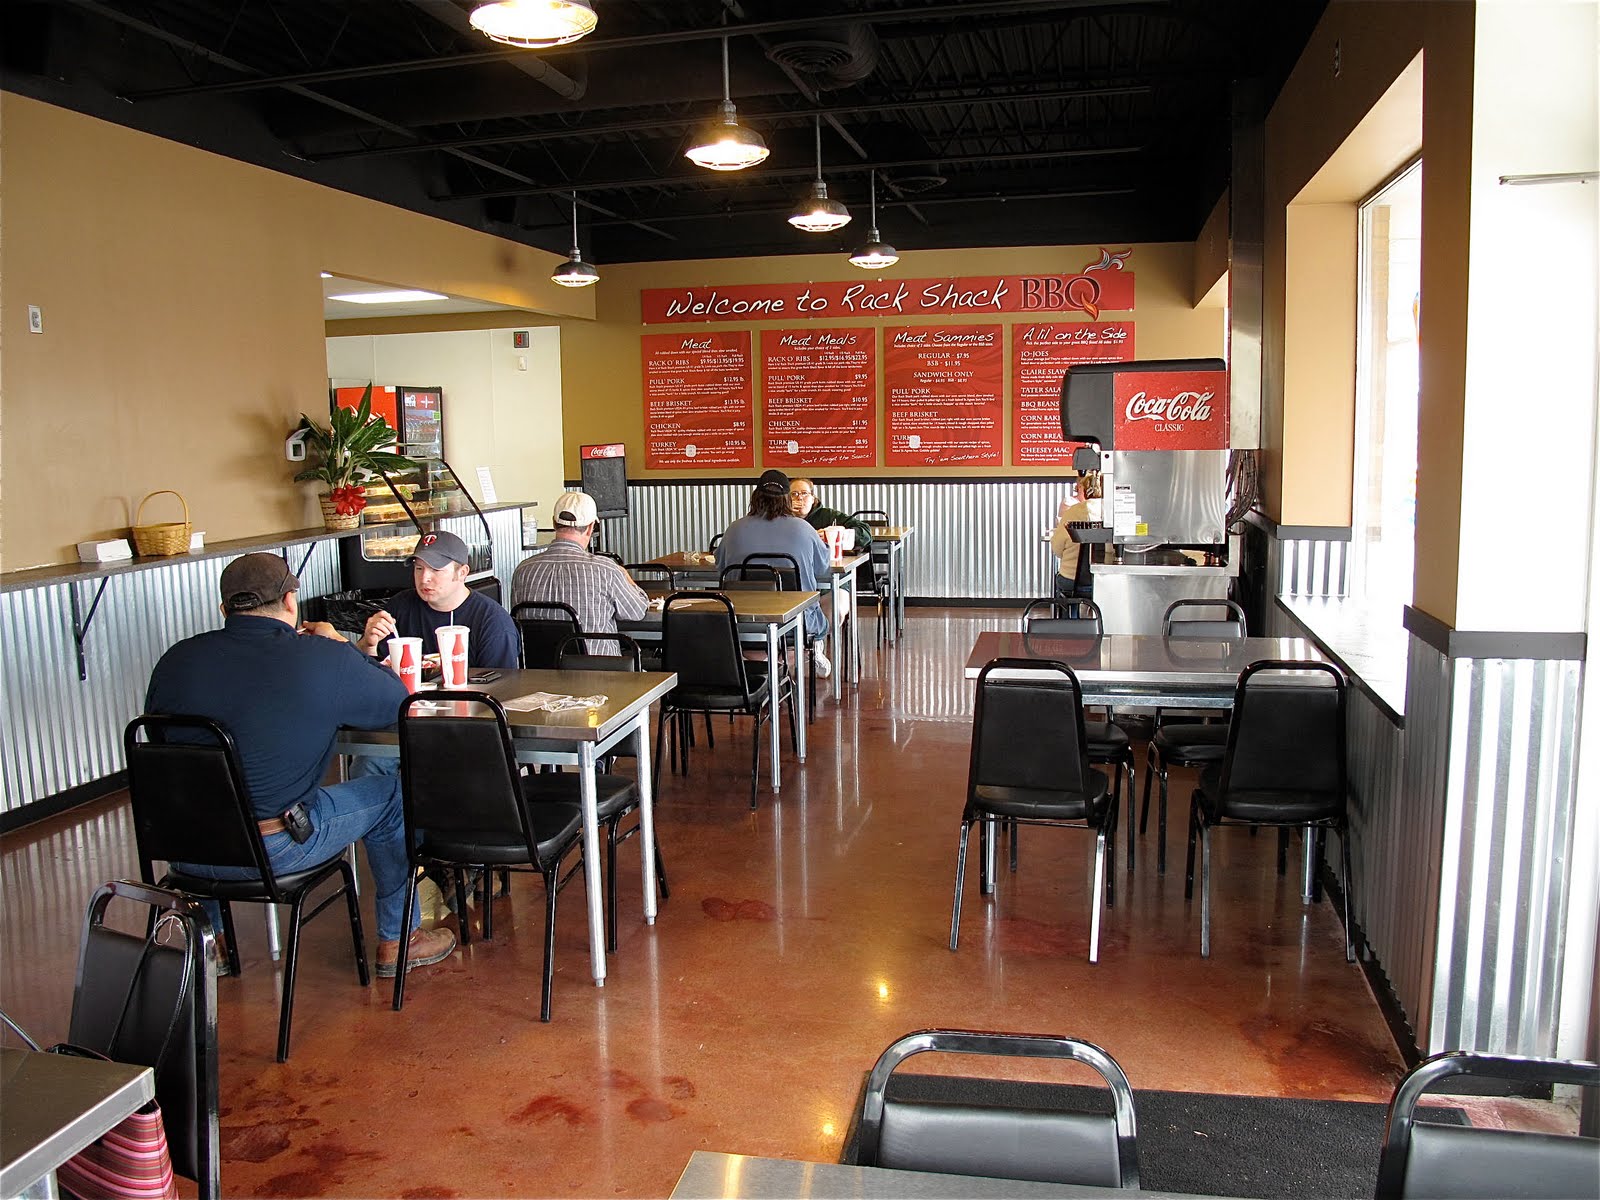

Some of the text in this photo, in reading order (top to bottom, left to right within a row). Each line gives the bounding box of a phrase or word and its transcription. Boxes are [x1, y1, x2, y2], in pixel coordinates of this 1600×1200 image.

[666, 276, 1100, 319] Welcome to Rack Shack BBQ
[894, 330, 994, 342] Meat Sammies
[1023, 327, 1035, 340] A
[1074, 328, 1096, 340] the
[1101, 327, 1127, 339] Side
[681, 338, 712, 350] Meat
[780, 334, 856, 346] Meat Meals
[1126, 392, 1215, 421] Coca-Cola
[1154, 424, 1184, 432] CLASSIC
